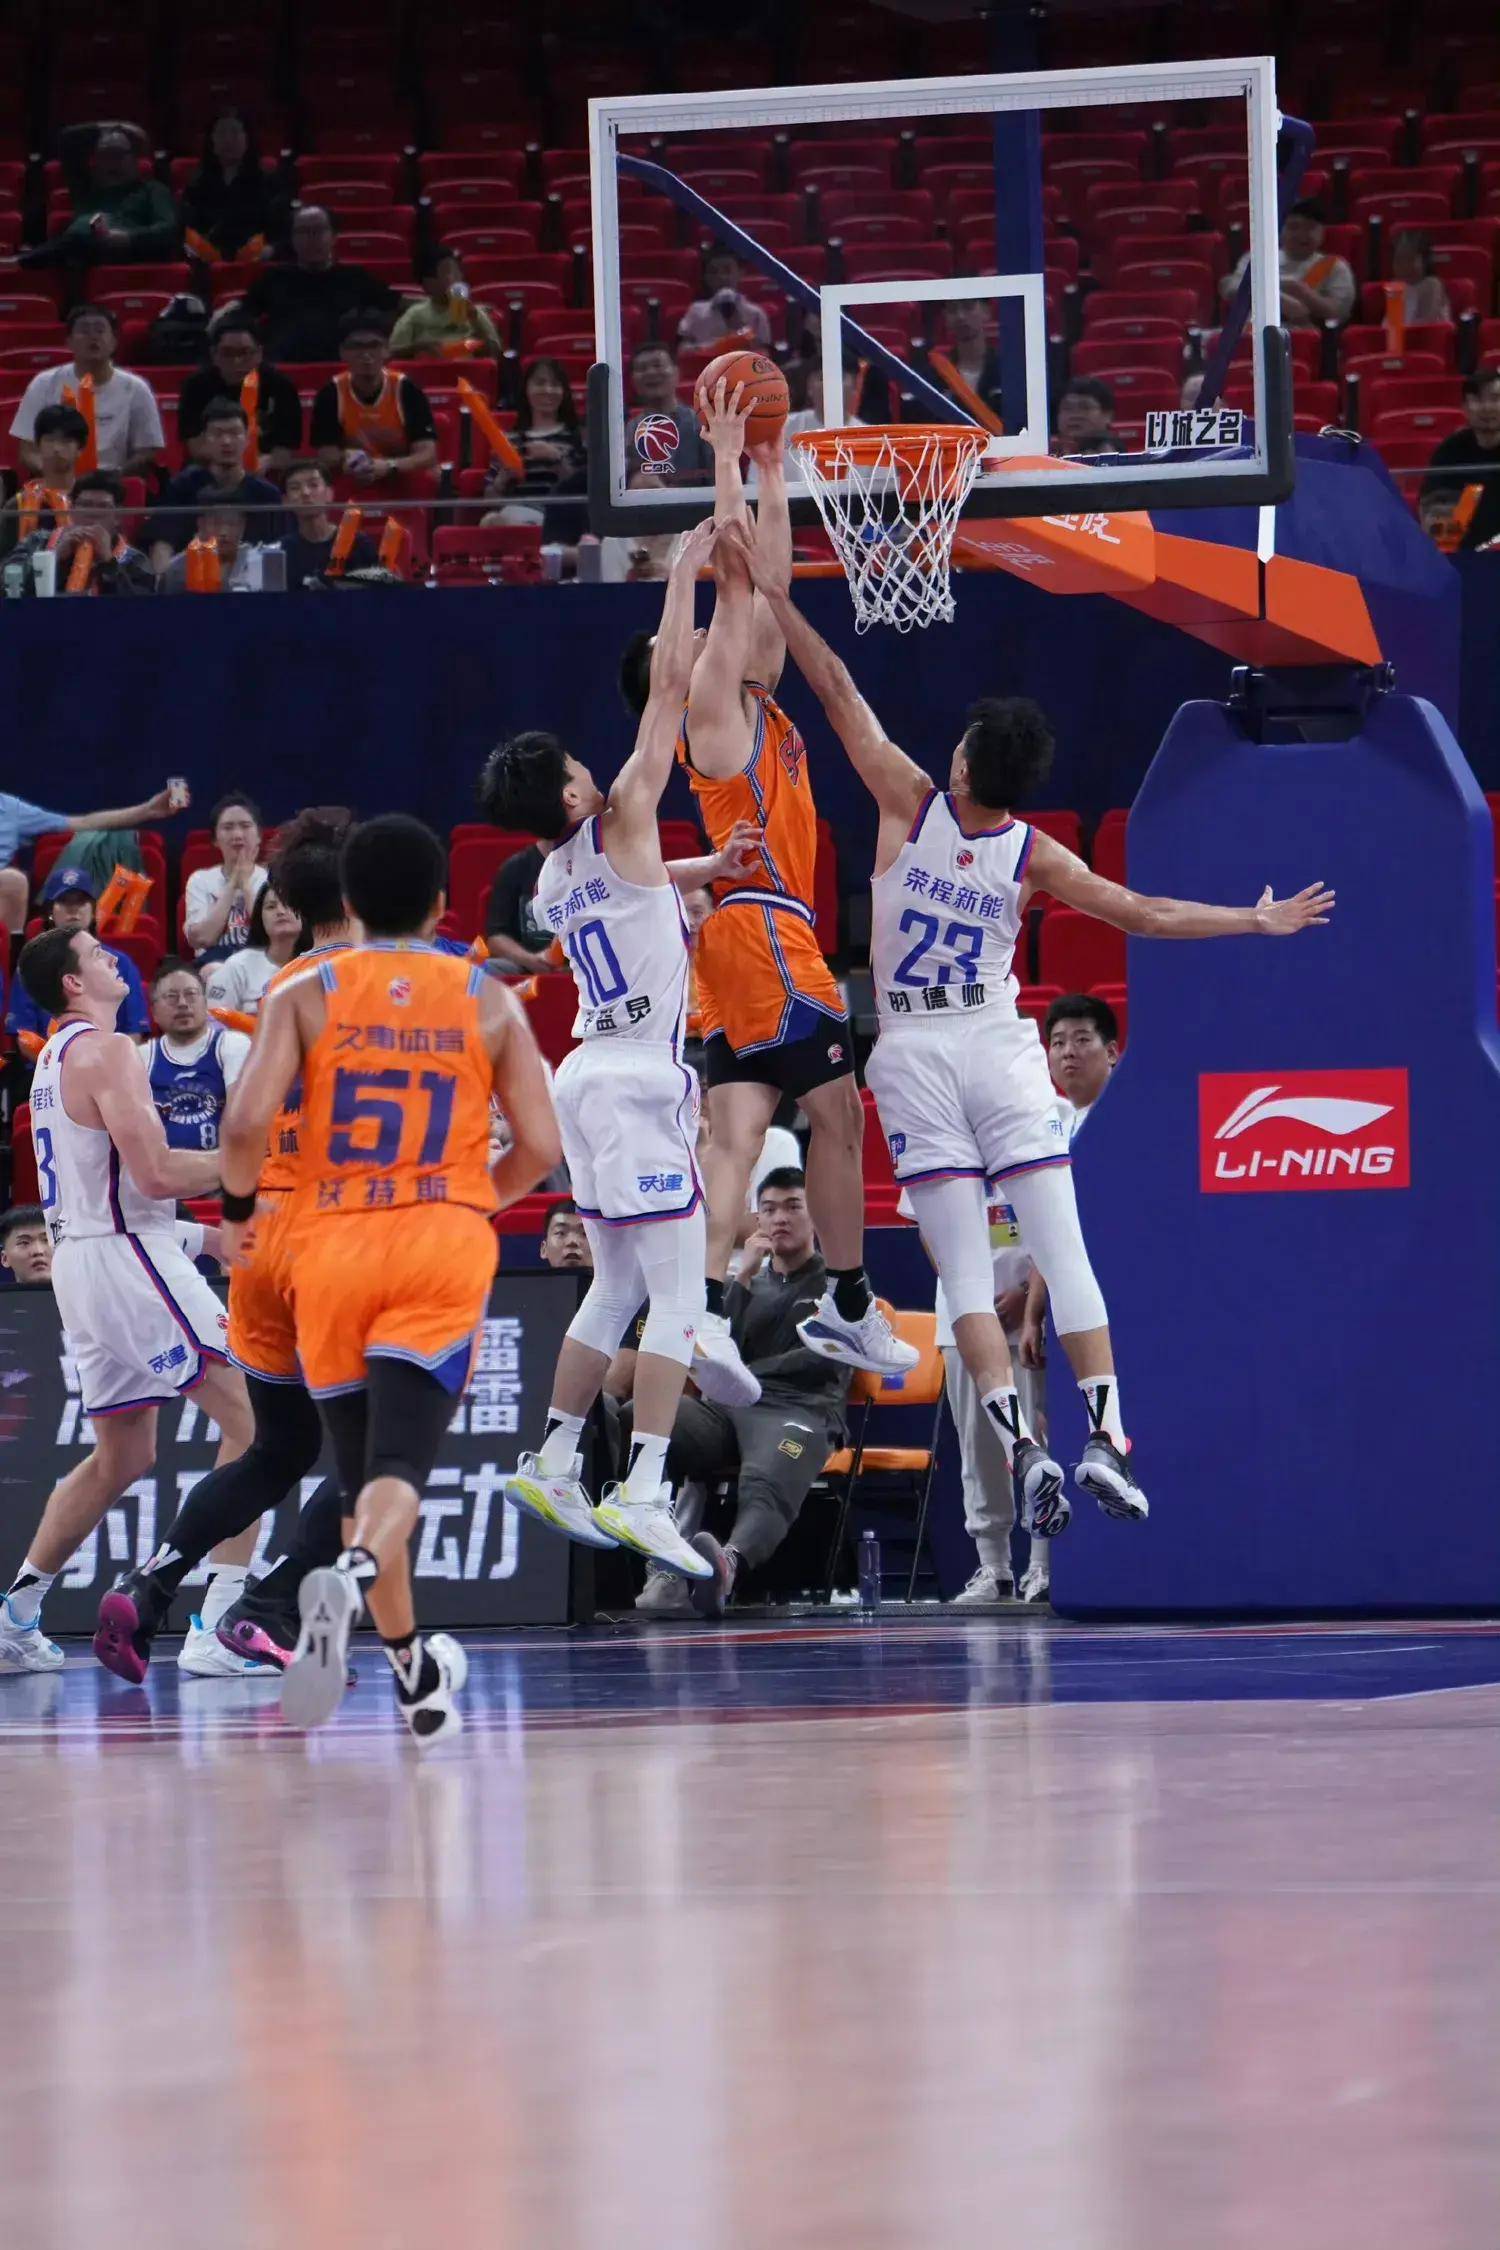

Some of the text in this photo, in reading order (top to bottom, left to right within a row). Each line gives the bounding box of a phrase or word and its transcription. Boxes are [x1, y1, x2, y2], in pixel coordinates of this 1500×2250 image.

[1146, 410, 1241, 448] 以城之名
[641, 462, 676, 473] CBA
[903, 867, 1004, 920] 荣程新能
[568, 919, 628, 1008] 10
[893, 908, 984, 988] 23
[200, 1122, 216, 1150] 8
[327, 1067, 457, 1168] 51
[1215, 1147, 1395, 1178] LI-NING
